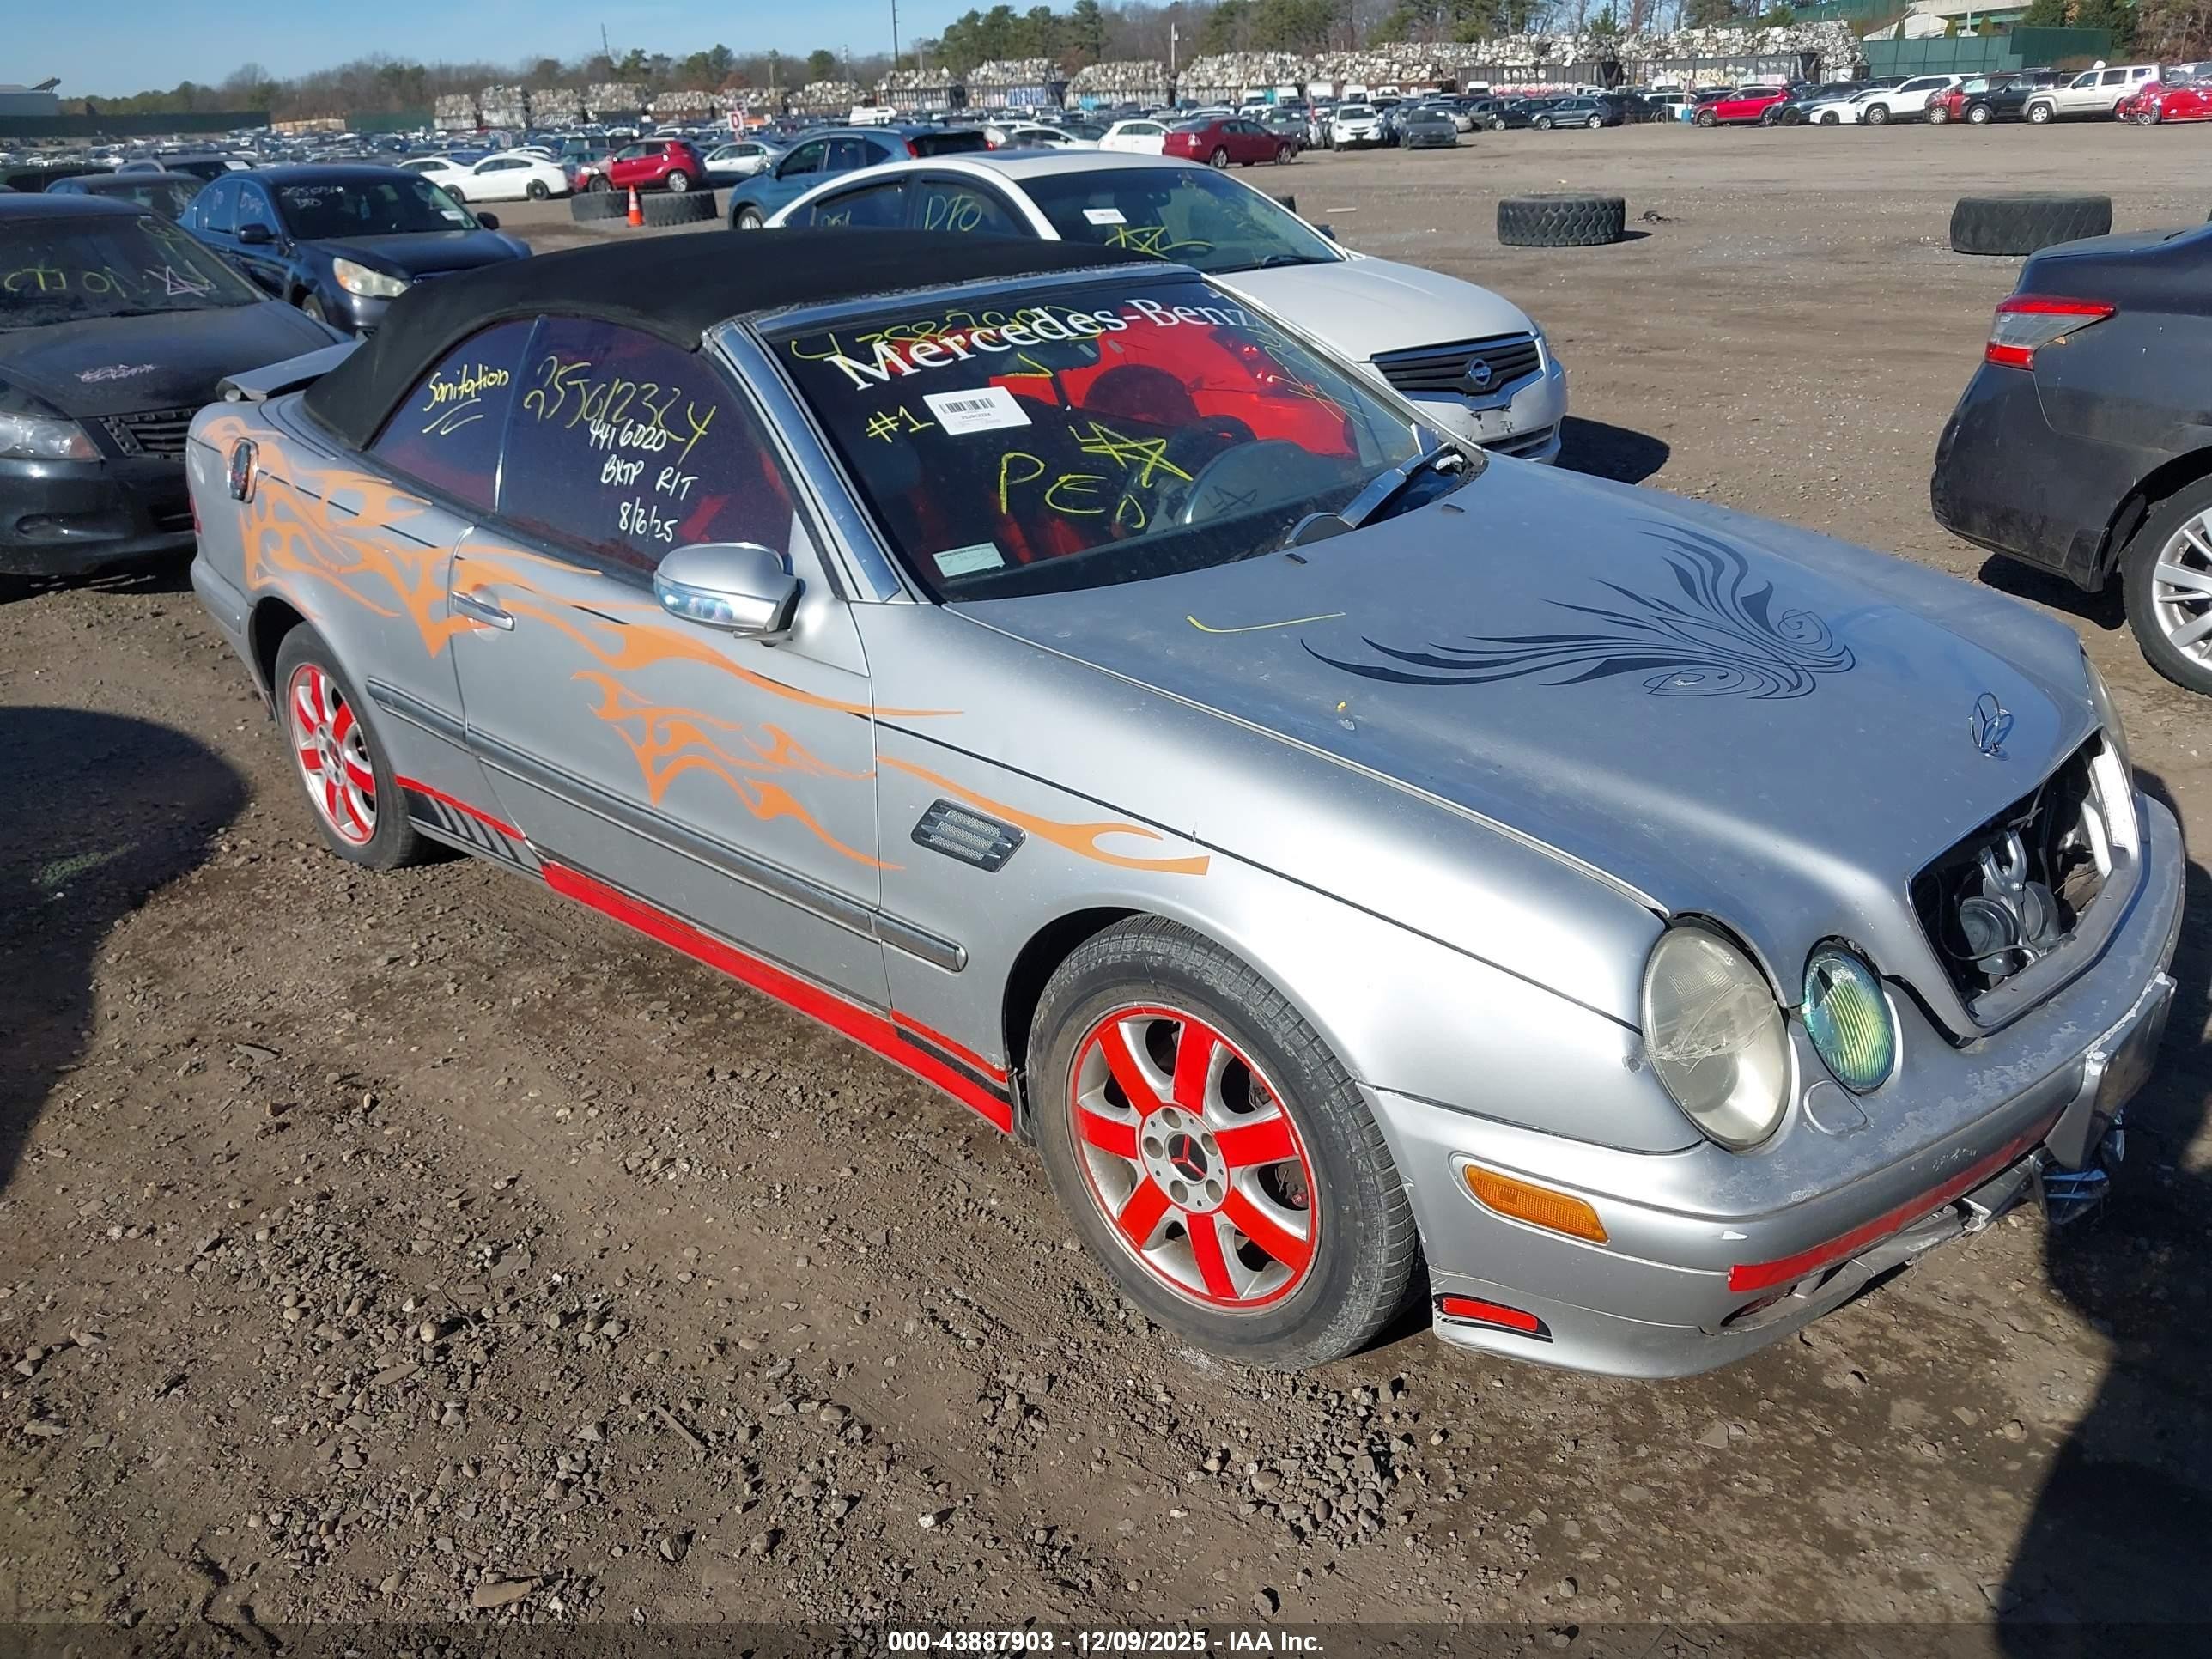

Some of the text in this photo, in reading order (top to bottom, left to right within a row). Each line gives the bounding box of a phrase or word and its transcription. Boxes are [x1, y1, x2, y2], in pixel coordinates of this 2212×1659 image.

[823, 299, 1261, 392] Mercedes-Benz
[422, 362, 510, 412] Sanitation
[865, 405, 935, 443] #1
